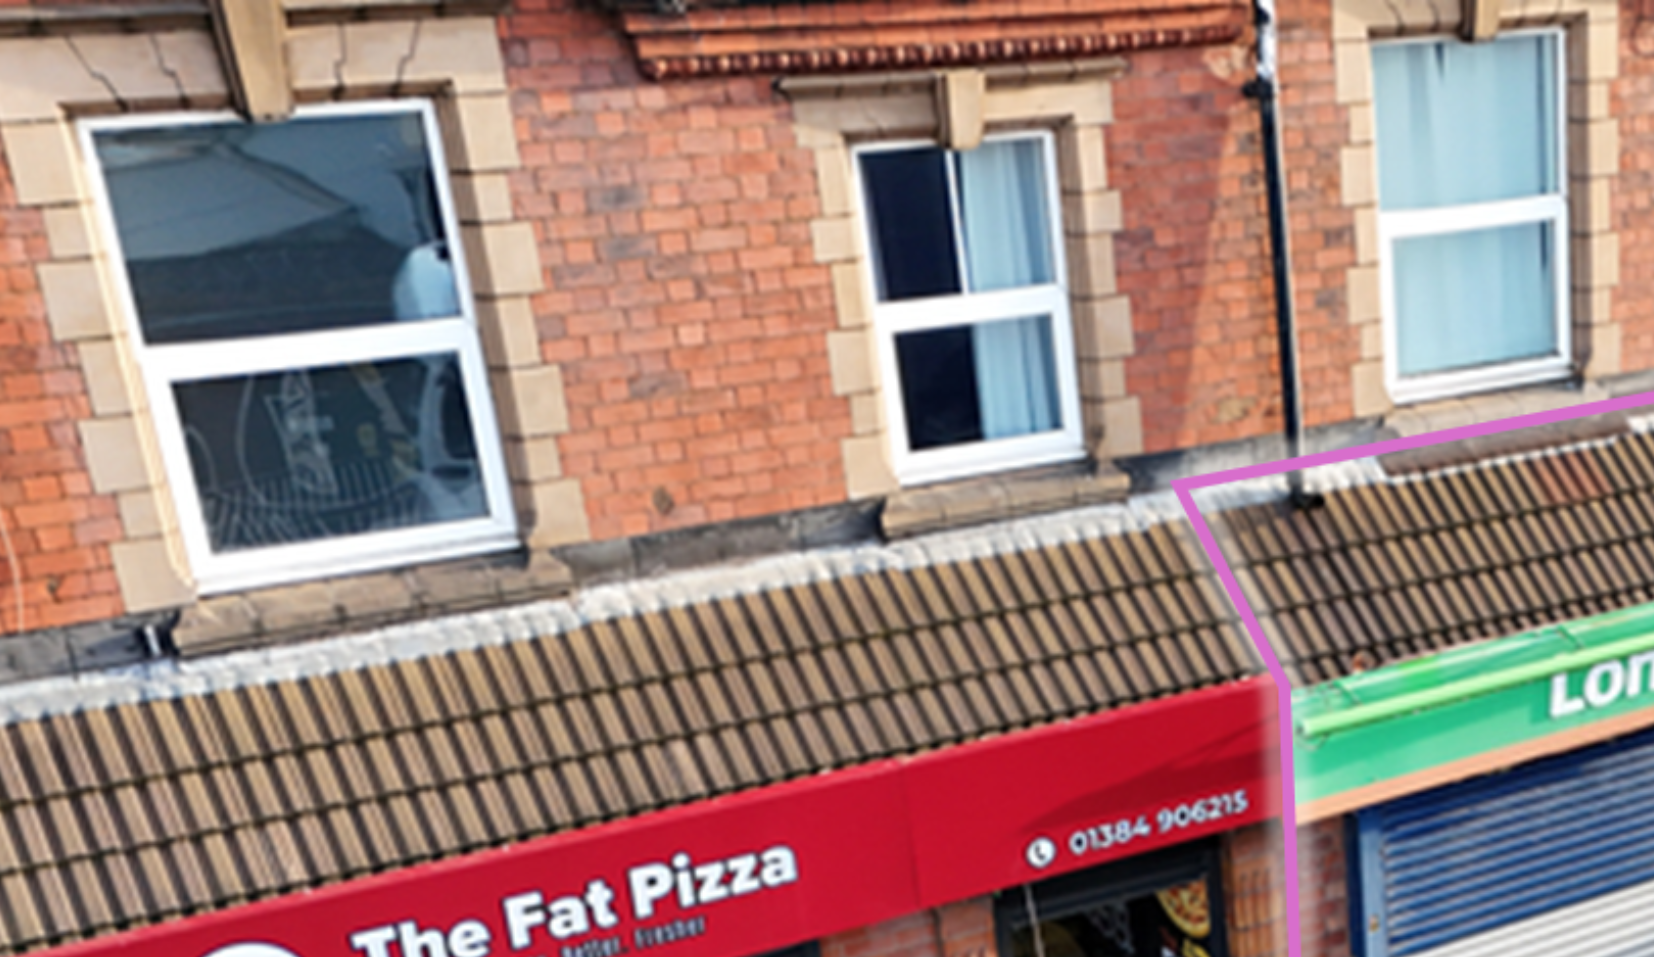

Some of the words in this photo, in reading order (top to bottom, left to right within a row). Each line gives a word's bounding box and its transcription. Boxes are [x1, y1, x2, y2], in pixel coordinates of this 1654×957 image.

[1069, 816, 1151, 855] 01384
[1157, 790, 1248, 833] 906215
[504, 879, 618, 949] Fat
[629, 844, 798, 918] Pizza
